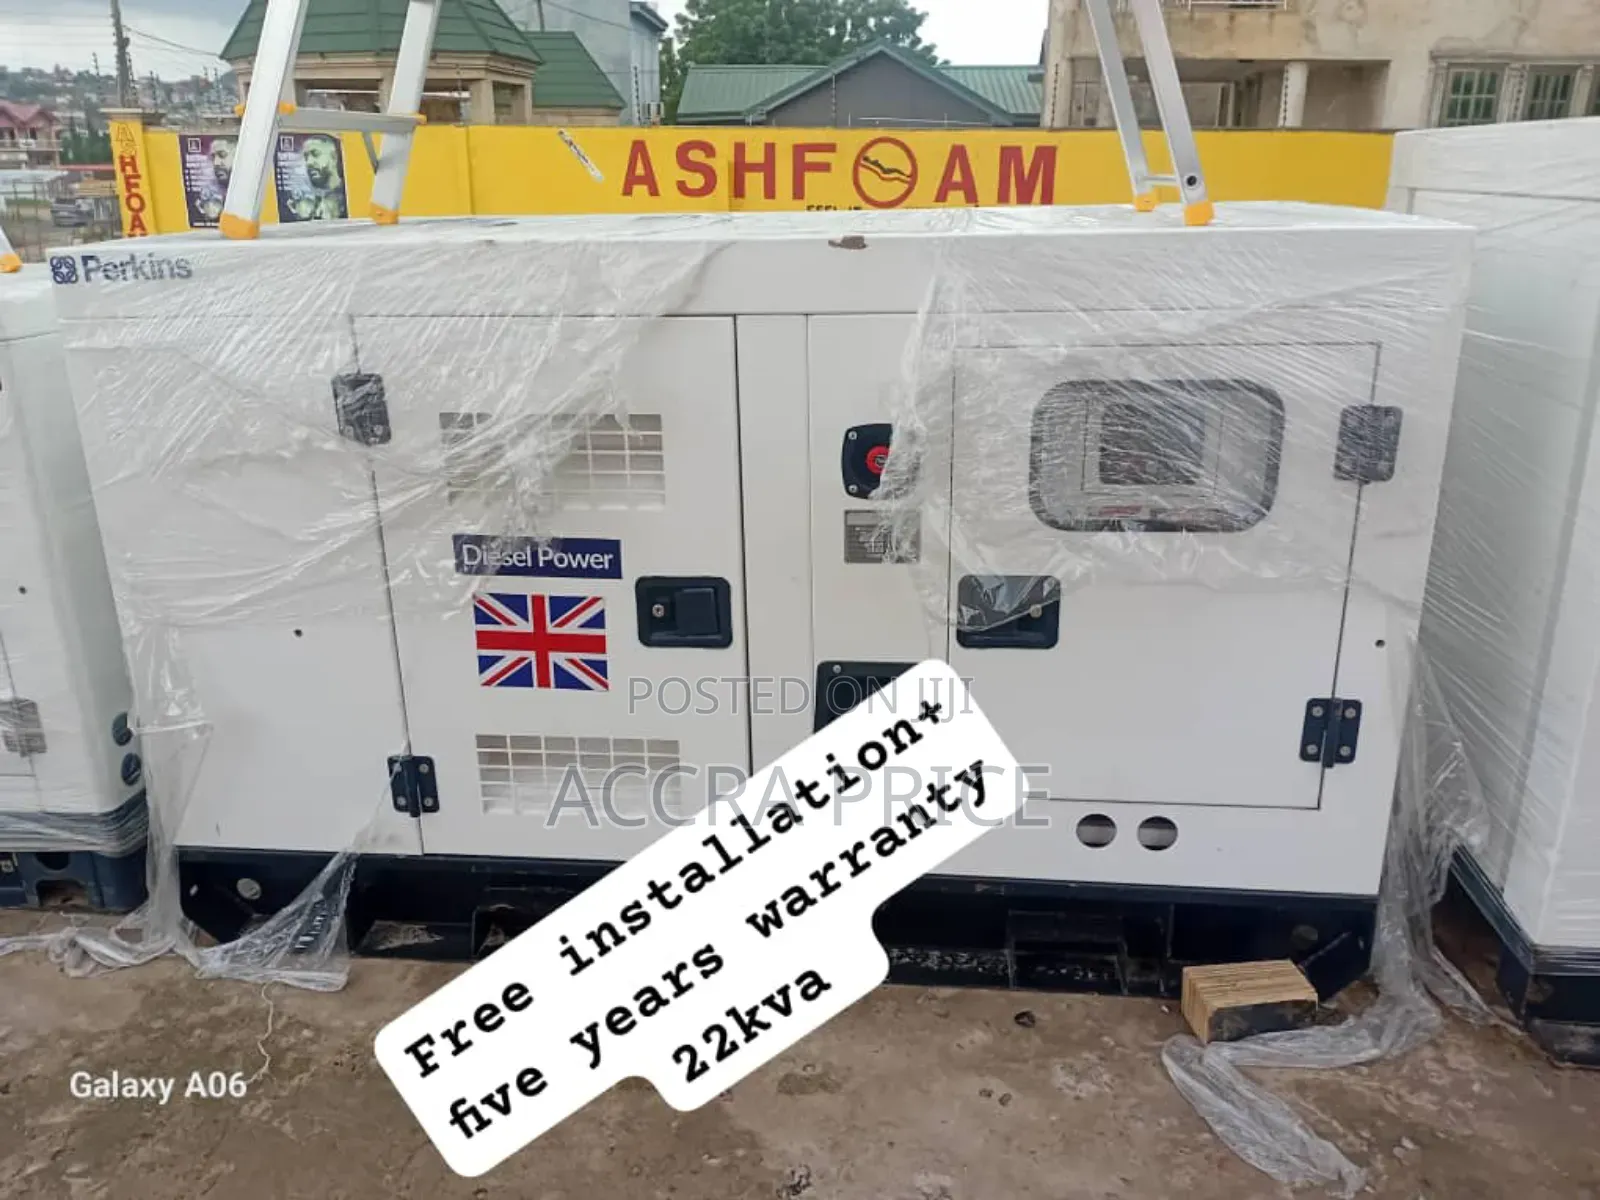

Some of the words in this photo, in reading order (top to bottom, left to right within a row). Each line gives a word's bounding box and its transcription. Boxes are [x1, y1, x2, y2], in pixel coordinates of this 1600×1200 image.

[81, 252, 193, 282] Perkins
[462, 543, 532, 567] Diesel
[538, 547, 614, 569] Power
